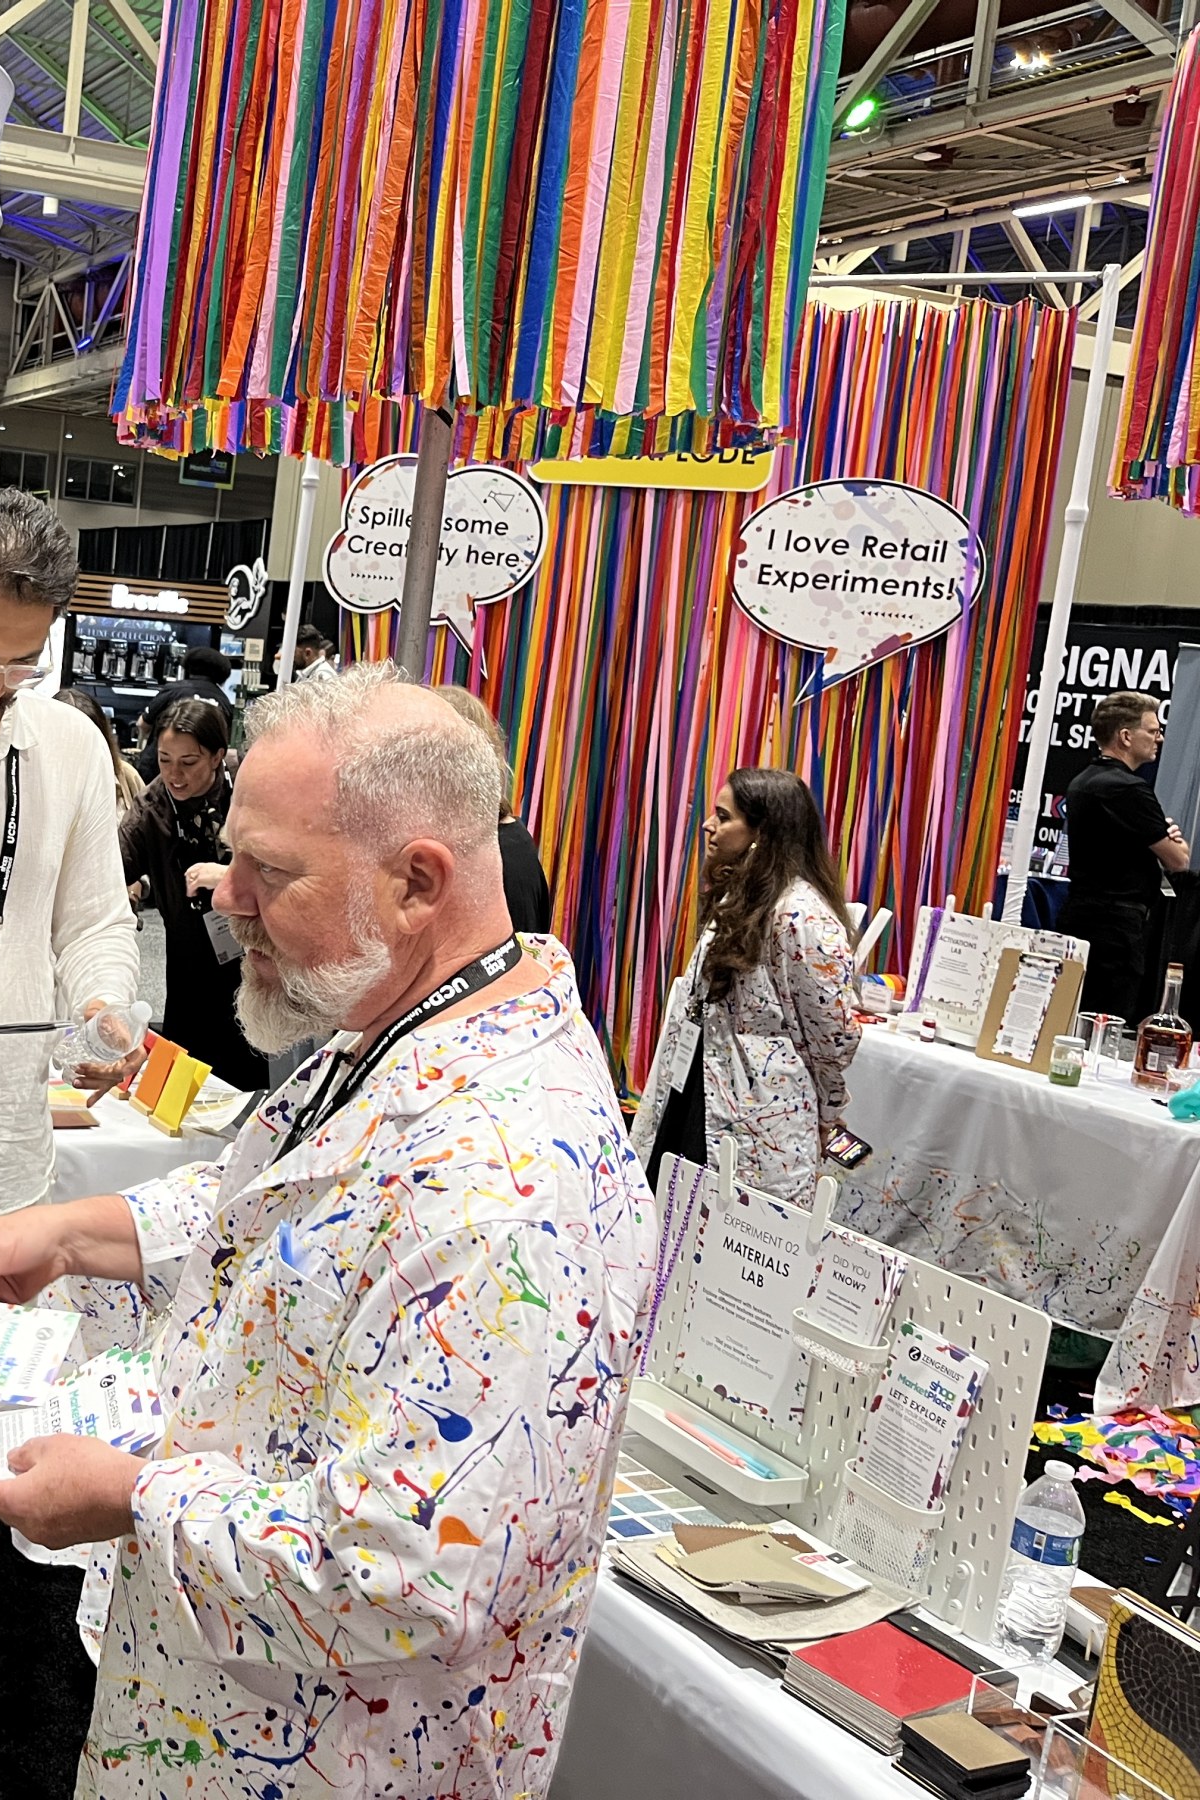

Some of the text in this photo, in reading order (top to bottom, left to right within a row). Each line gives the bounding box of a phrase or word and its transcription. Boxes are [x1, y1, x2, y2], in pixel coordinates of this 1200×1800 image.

[443, 516, 509, 536] some
[466, 544, 520, 568] here
[768, 528, 948, 563] I love Retail
[757, 563, 955, 601] Experiments!
[7, 821, 16, 844] UCD
[428, 977, 469, 1006] UCD
[724, 1212, 800, 1256] EXPERIMENT 02
[723, 1236, 790, 1278] MATERIALS
[832, 1254, 871, 1279] DID YOU
[741, 1266, 764, 1288] LAB
[832, 1270, 867, 1293] KNOW?
[889, 1387, 948, 1428] LET'S EXPLORE
[897, 1374, 953, 1412] MarketPlace
